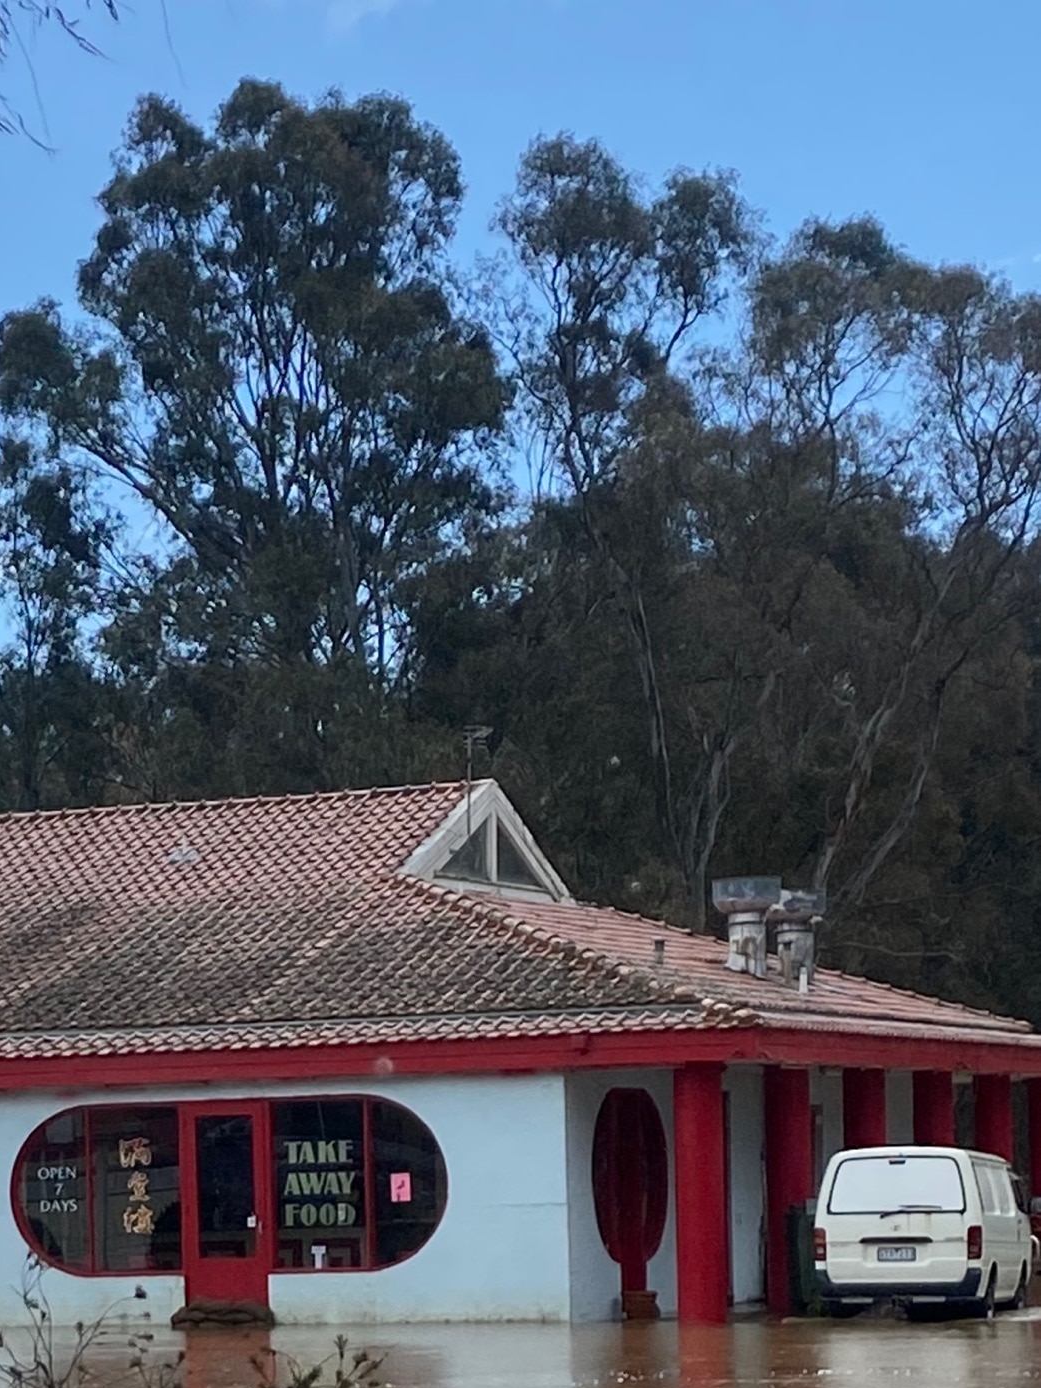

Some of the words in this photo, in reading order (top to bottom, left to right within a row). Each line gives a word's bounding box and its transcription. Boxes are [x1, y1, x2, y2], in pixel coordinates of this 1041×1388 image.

[283, 1140, 354, 1164] TAKE
[37, 1166, 77, 1180] OPEN
[55, 1183, 64, 1197] 7
[284, 1171, 356, 1195] AWAY
[40, 1199, 78, 1213] DAYS
[285, 1203, 356, 1227] FOOD
